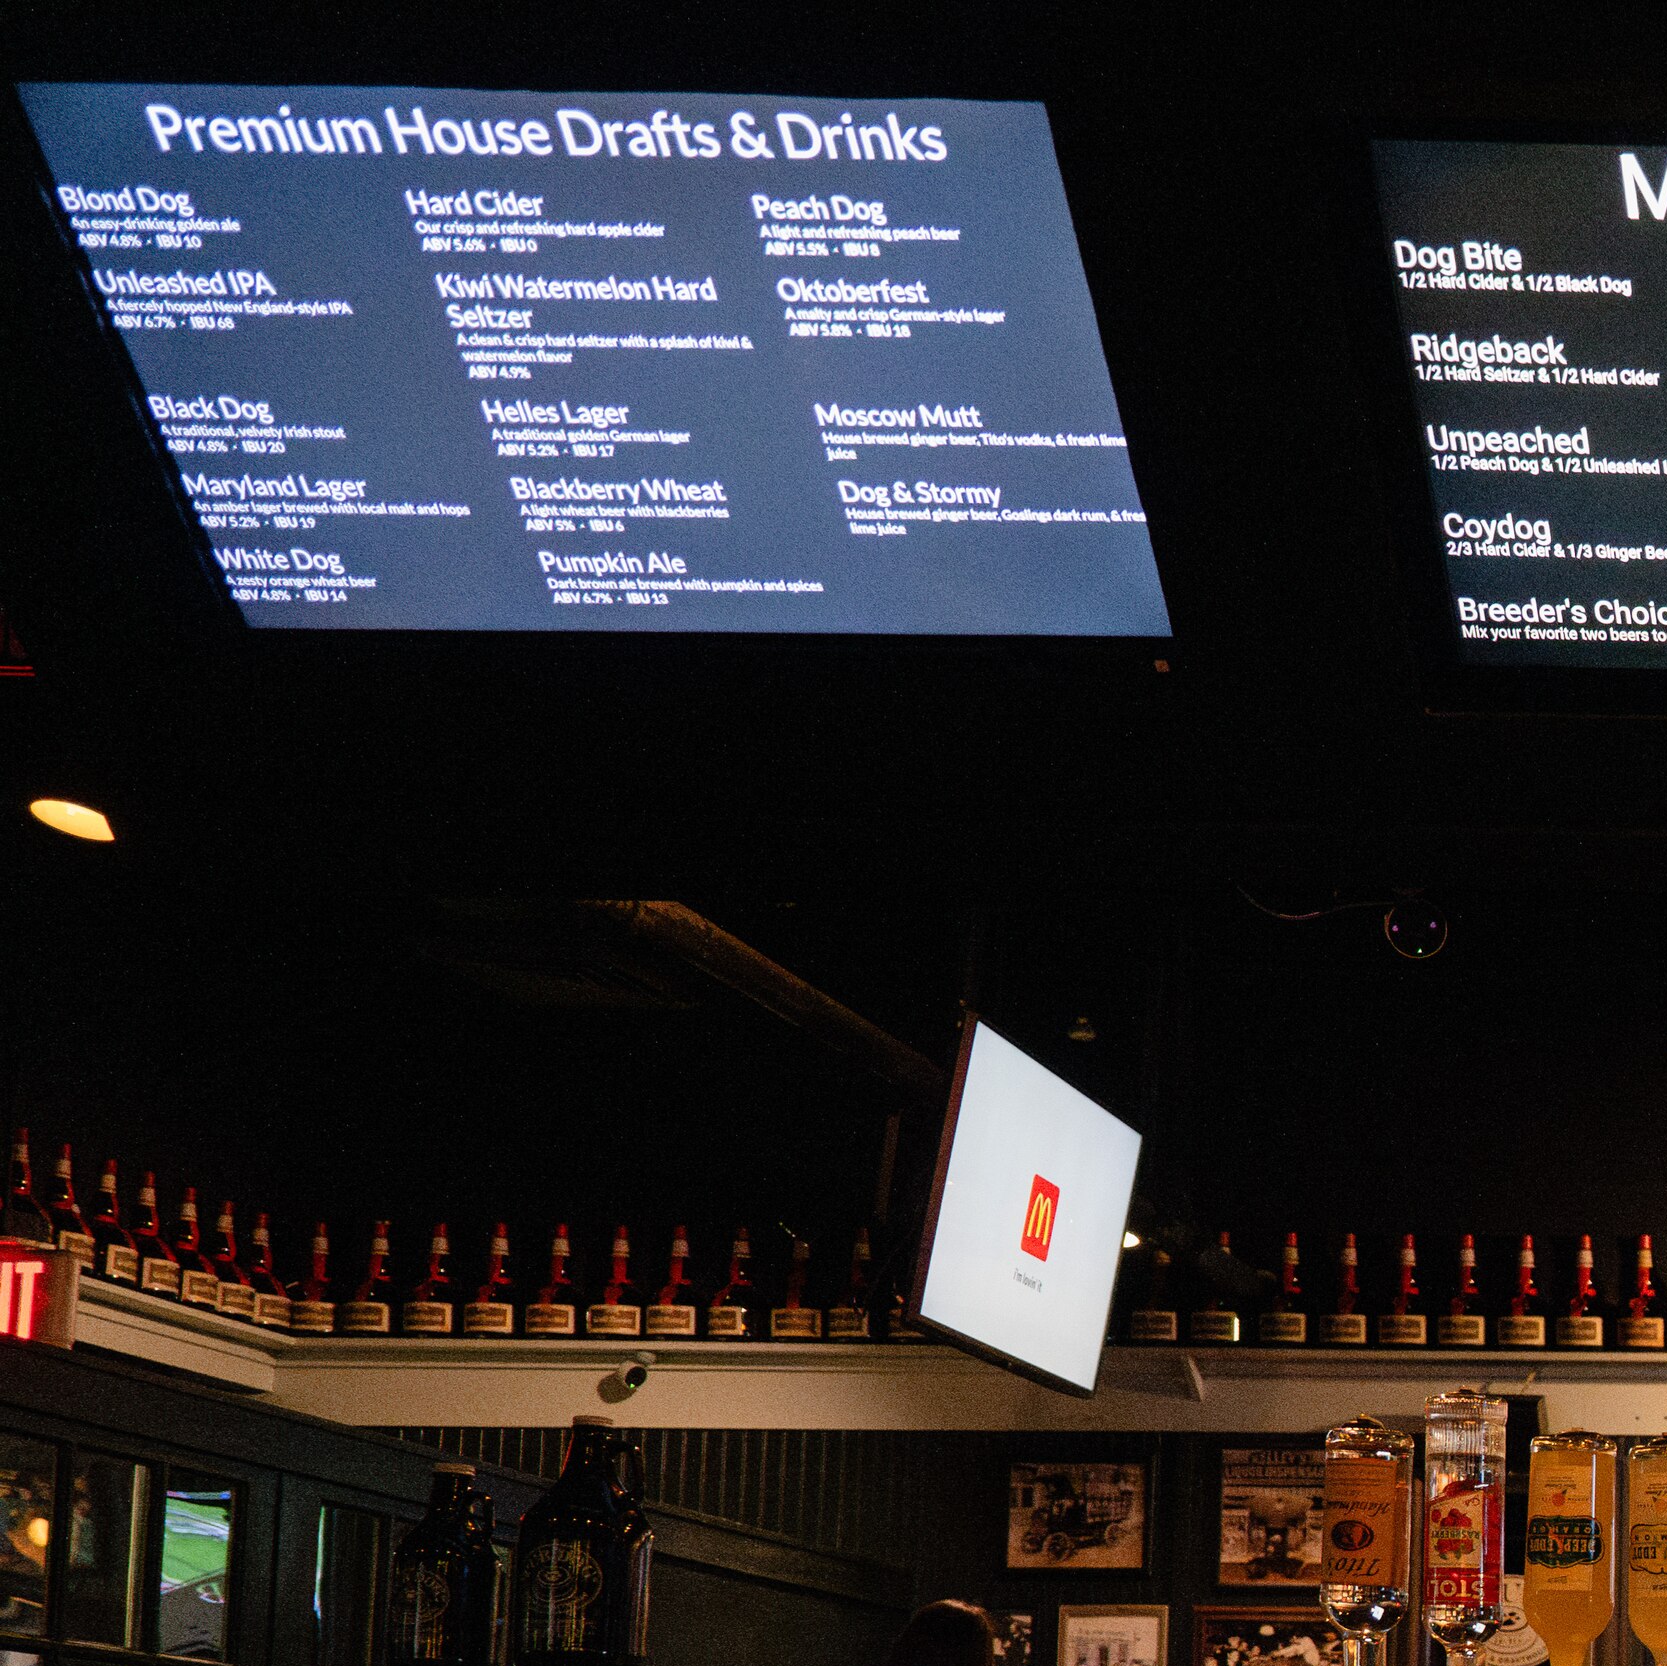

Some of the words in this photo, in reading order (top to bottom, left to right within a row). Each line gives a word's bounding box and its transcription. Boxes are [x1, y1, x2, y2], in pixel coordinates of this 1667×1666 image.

[145, 104, 382, 154] Premium
[385, 106, 553, 156] House
[559, 110, 721, 159] Drafts
[730, 112, 774, 161] &
[777, 112, 947, 162] Drinks
[57, 185, 134, 213] Blond
[137, 187, 195, 216] Dog
[1395, 240, 1456, 274] Dog
[1462, 242, 1522, 272] Bite
[94, 270, 226, 296] Unleashed
[230, 272, 277, 296] IPA
[182, 473, 296, 502] Maryland
[299, 476, 366, 501] Lager
[215, 548, 289, 570] White
[292, 549, 345, 575] Dog
[238, 576, 267, 590] zesty
[270, 577, 310, 590] orange
[312, 576, 348, 588] wheat
[350, 576, 377, 588] beer
[1457, 598, 1587, 626] Breeder's
[1462, 625, 1486, 639] Mix
[1488, 627, 1521, 641] your
[1524, 626, 1576, 641] favorite
[1580, 628, 1607, 641] two
[1610, 627, 1650, 642] beers
[1328, 1557, 1380, 1578] Tito's
